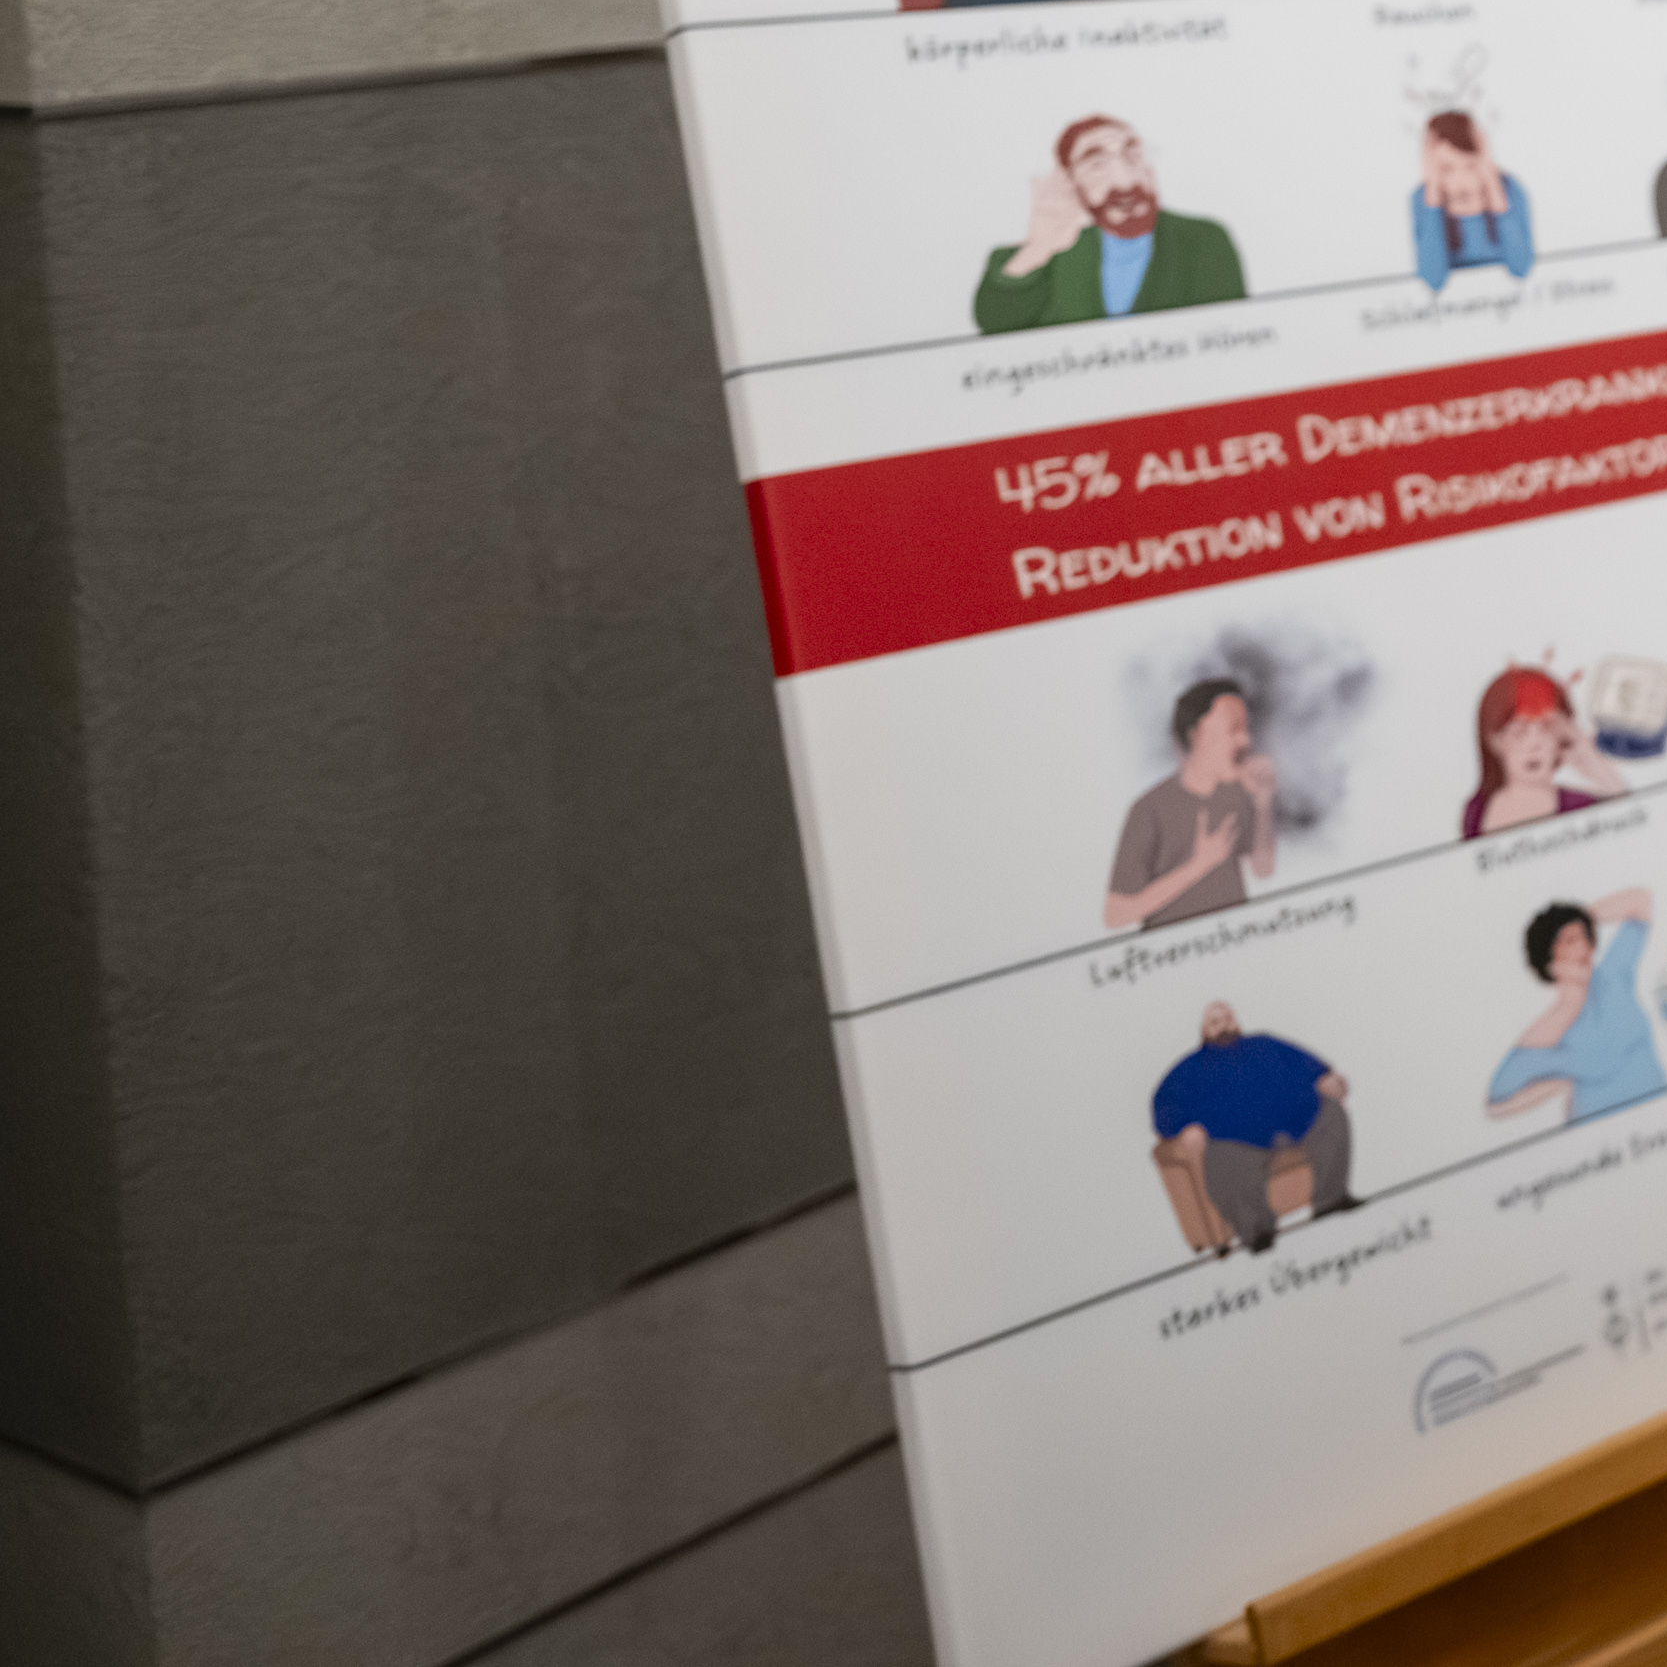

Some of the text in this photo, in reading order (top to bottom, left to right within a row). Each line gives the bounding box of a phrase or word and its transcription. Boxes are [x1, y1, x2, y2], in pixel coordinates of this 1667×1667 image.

[905, 27, 1068, 70] körperliche
[996, 450, 1121, 513] 45%
[1137, 431, 1288, 492] ALLER
[1012, 511, 1283, 600] REDUKTION
[1293, 492, 1385, 542] VON
[1088, 895, 1356, 989] Luftverschmutzung
[1159, 1214, 1432, 1340] starkes Übergewicht
